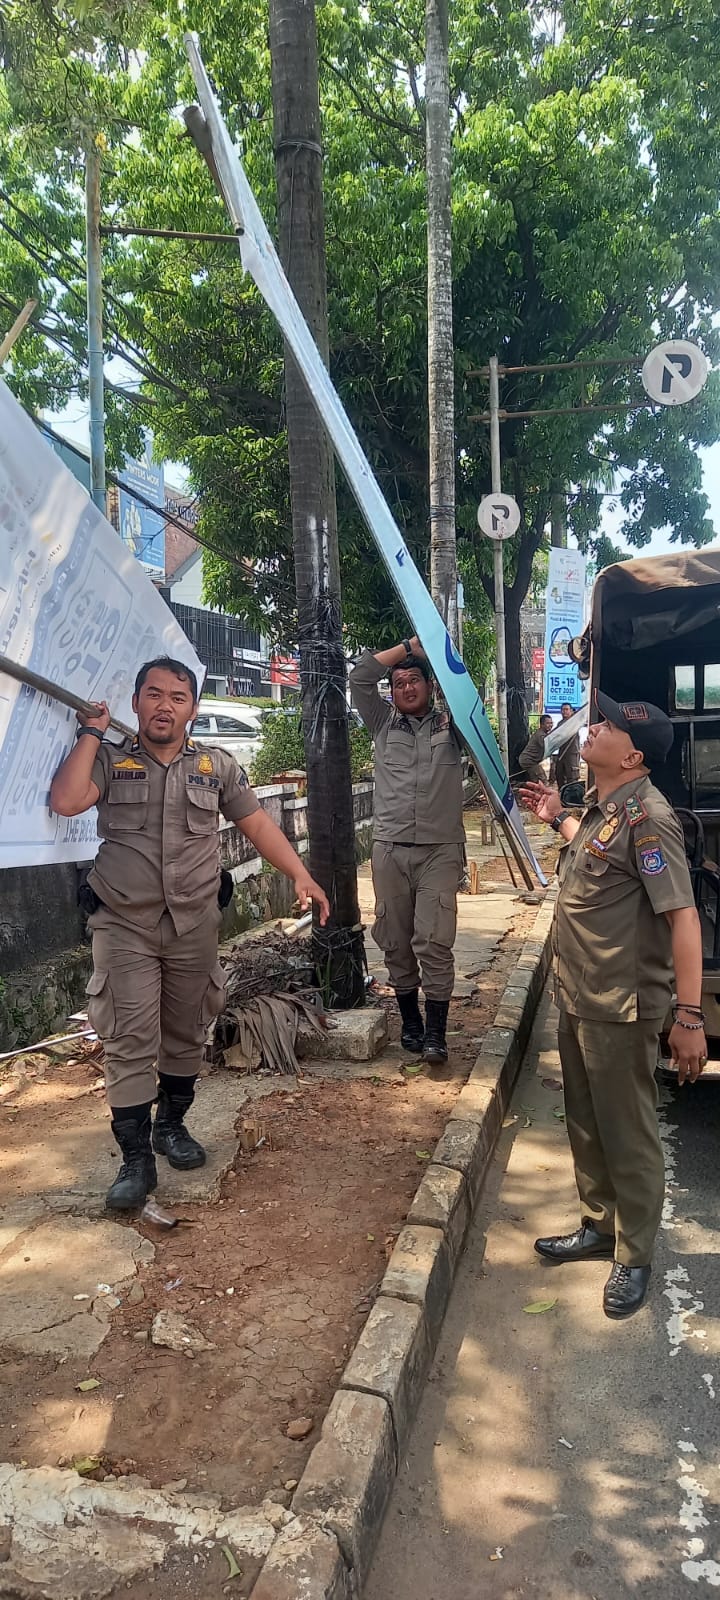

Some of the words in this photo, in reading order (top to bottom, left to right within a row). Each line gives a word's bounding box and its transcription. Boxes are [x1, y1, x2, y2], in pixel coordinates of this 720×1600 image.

[661, 353, 692, 393] P
[491, 504, 510, 531] P
[550, 677, 560, 687] 15
[566, 678, 575, 687] 19
[188, 775, 205, 786] POL
[208, 777, 220, 788] PP
